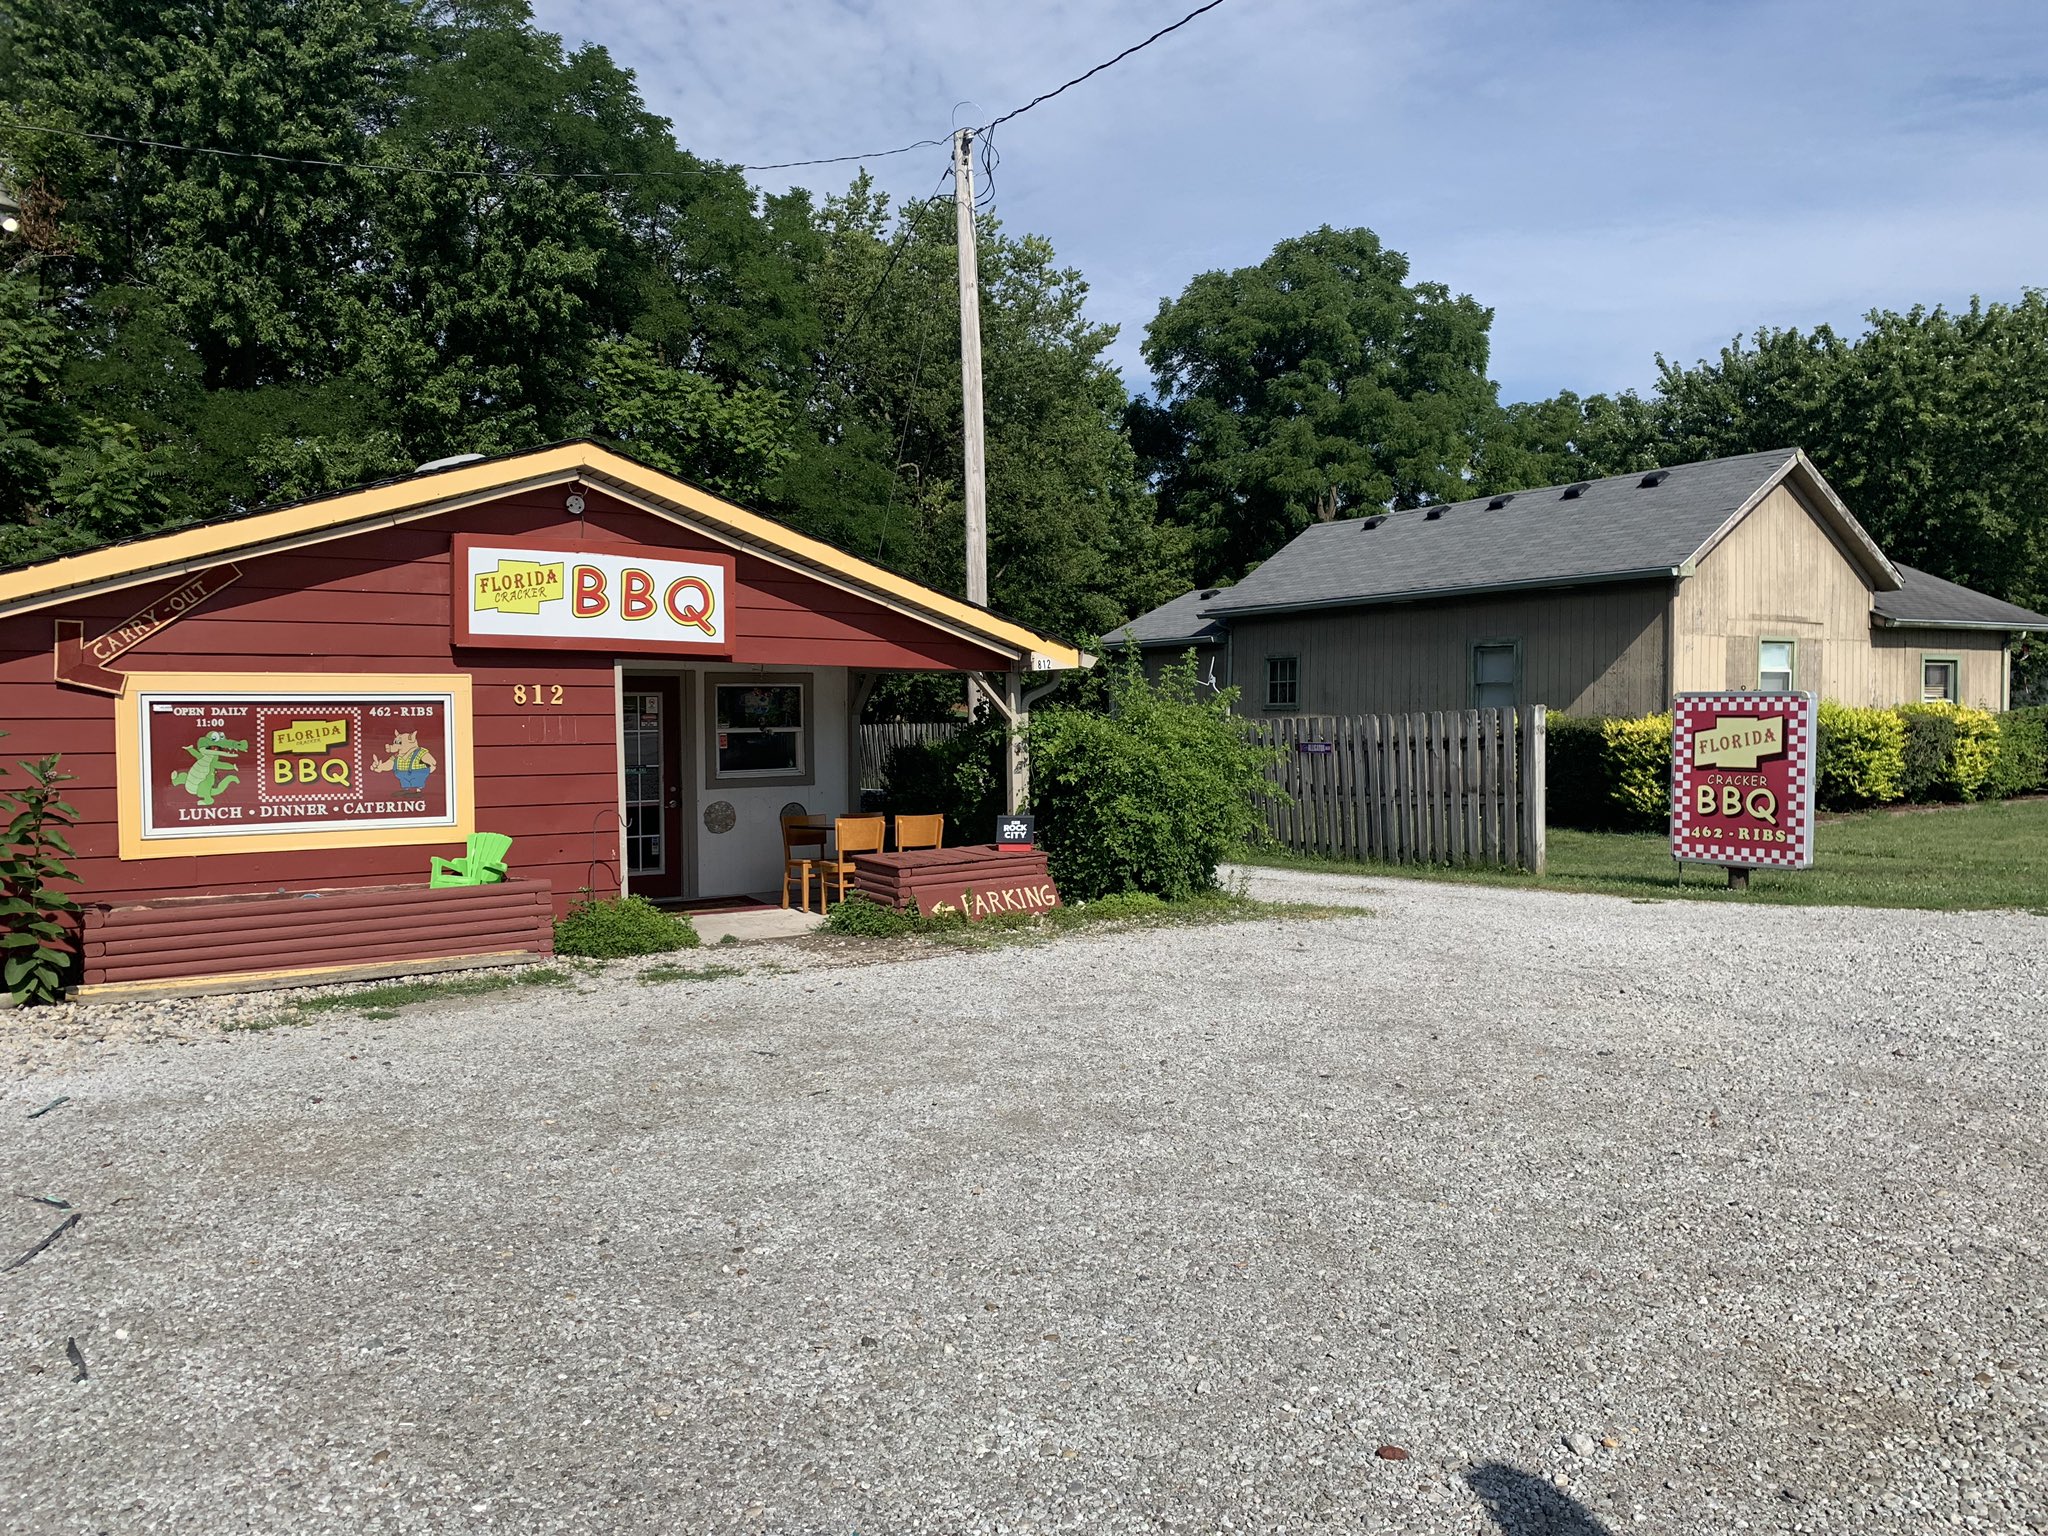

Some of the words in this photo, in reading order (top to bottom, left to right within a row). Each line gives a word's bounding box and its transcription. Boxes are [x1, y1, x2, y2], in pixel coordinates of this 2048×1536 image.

[480, 569, 558, 594] FLORIDA
[494, 587, 548, 603] CRACKER
[572, 564, 716, 637] BBQ
[1038, 660, 1051, 669] 812
[513, 684, 564, 705] 812
[173, 707, 205, 716] OPEN
[211, 707, 248, 716] DAILY
[196, 719, 225, 727] 11:00
[277, 726, 341, 744] FLORIDA
[1699, 728, 1776, 755] FLORIDA
[274, 758, 350, 787] BBQ
[1708, 774, 1768, 786] CRACKER
[179, 807, 243, 821] LUNCH
[260, 804, 328, 817] DINNER
[343, 801, 426, 814] CATERING
[1697, 785, 1777, 825] BBQ
[1004, 831, 1027, 839] CITY
